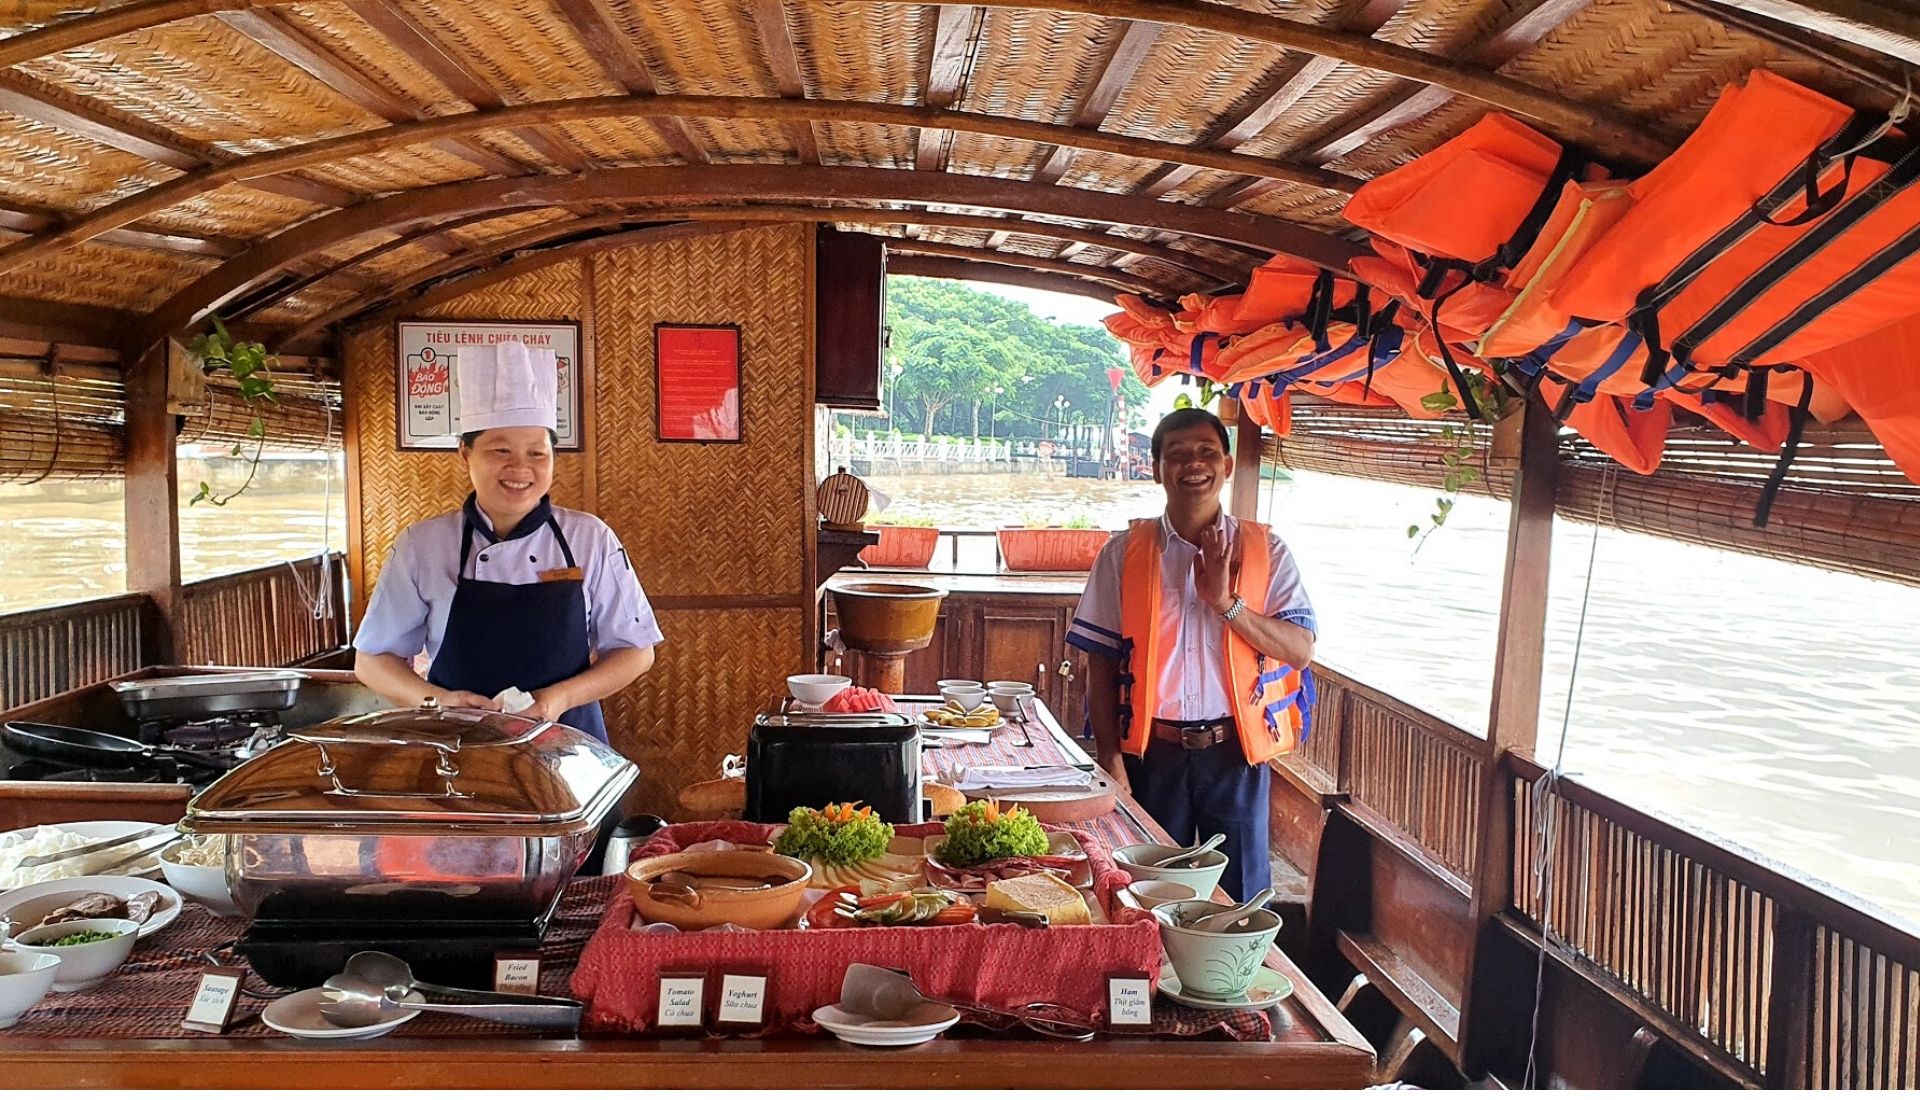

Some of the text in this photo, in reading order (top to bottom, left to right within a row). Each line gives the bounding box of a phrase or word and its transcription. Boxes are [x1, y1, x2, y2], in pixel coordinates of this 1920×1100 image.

[522, 331, 551, 345] CHÁY
[424, 350, 431, 360] 1
[507, 963, 528, 971] Fried
[203, 983, 230, 995] Sausage
[667, 988, 695, 996] Tomato
[728, 989, 758, 999] Yoghurt
[724, 1000, 758, 1009] Sữa chua
[676, 1009, 695, 1017] chua
